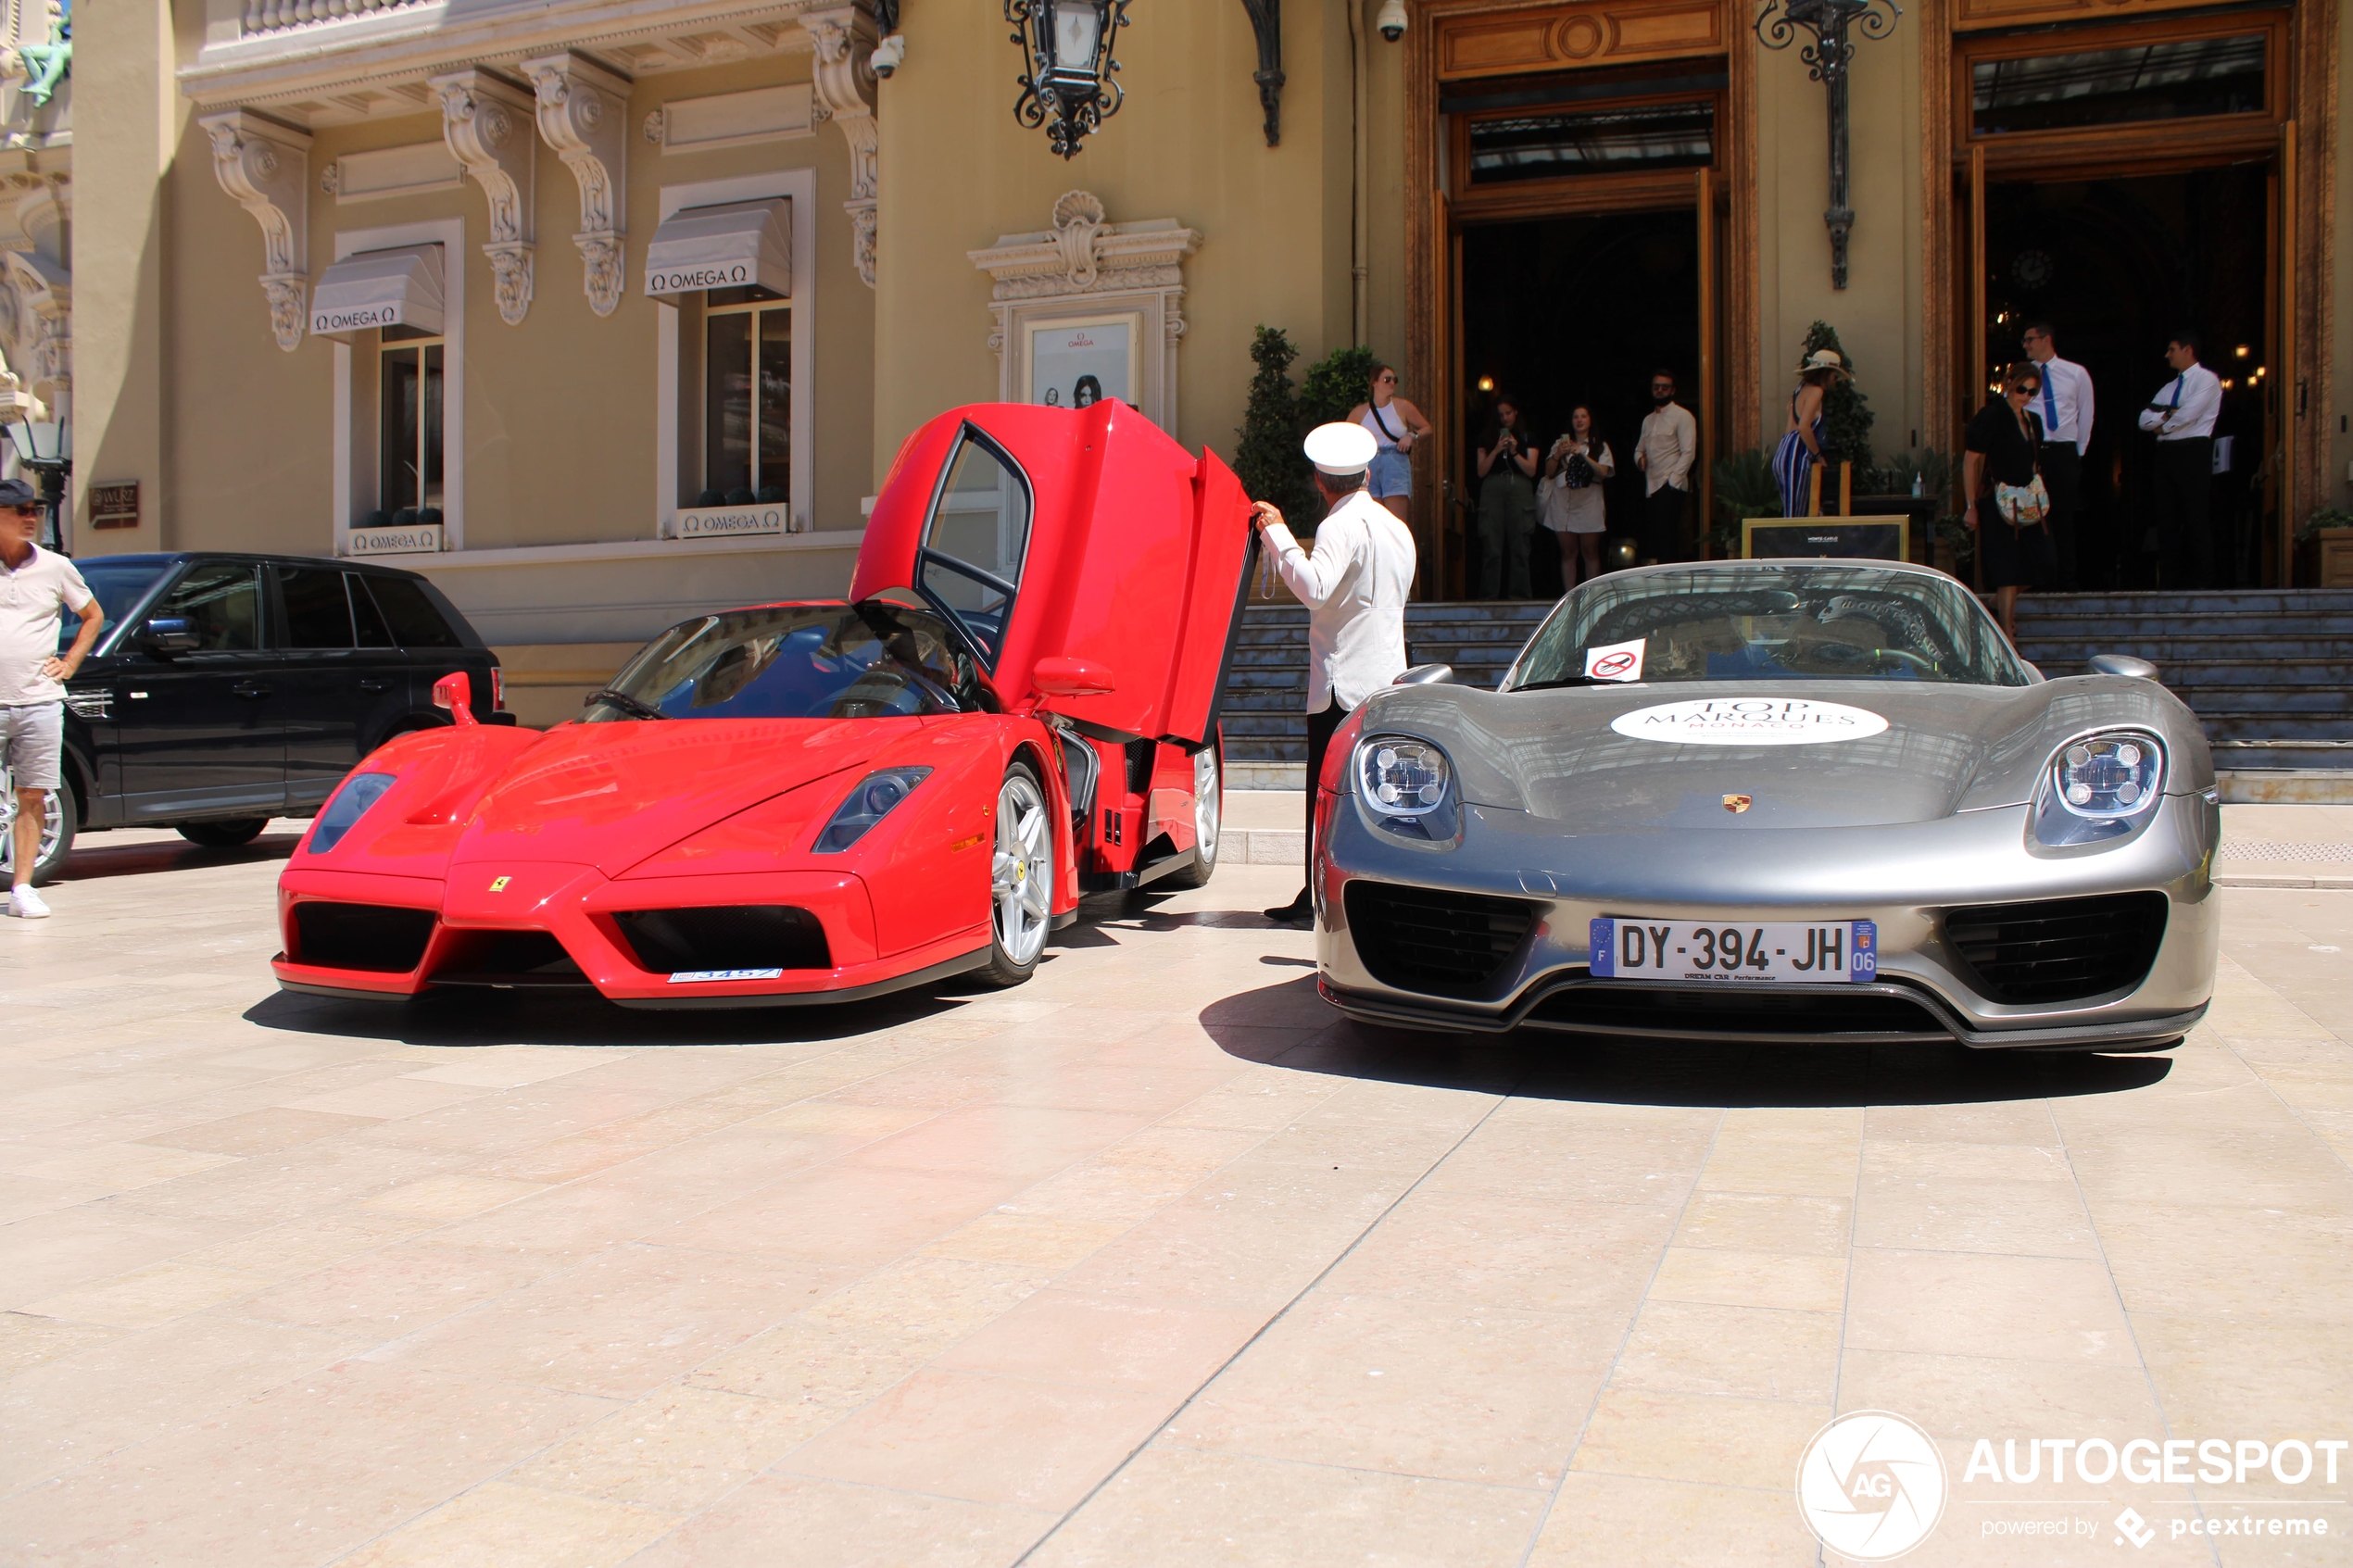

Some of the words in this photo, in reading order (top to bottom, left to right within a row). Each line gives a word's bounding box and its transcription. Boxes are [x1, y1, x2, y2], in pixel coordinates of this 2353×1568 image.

[670, 270, 727, 289] OMEGA
[331, 310, 379, 329] OMEGA
[703, 515, 759, 532] OMEGA
[371, 534, 417, 549] OMEGA
[1694, 702, 1809, 712] TOP
[1644, 713, 1855, 725] MARQUES
[1598, 949, 1606, 961] F
[1622, 925, 1843, 972] DY-394-JH
[1852, 952, 1875, 972] 06
